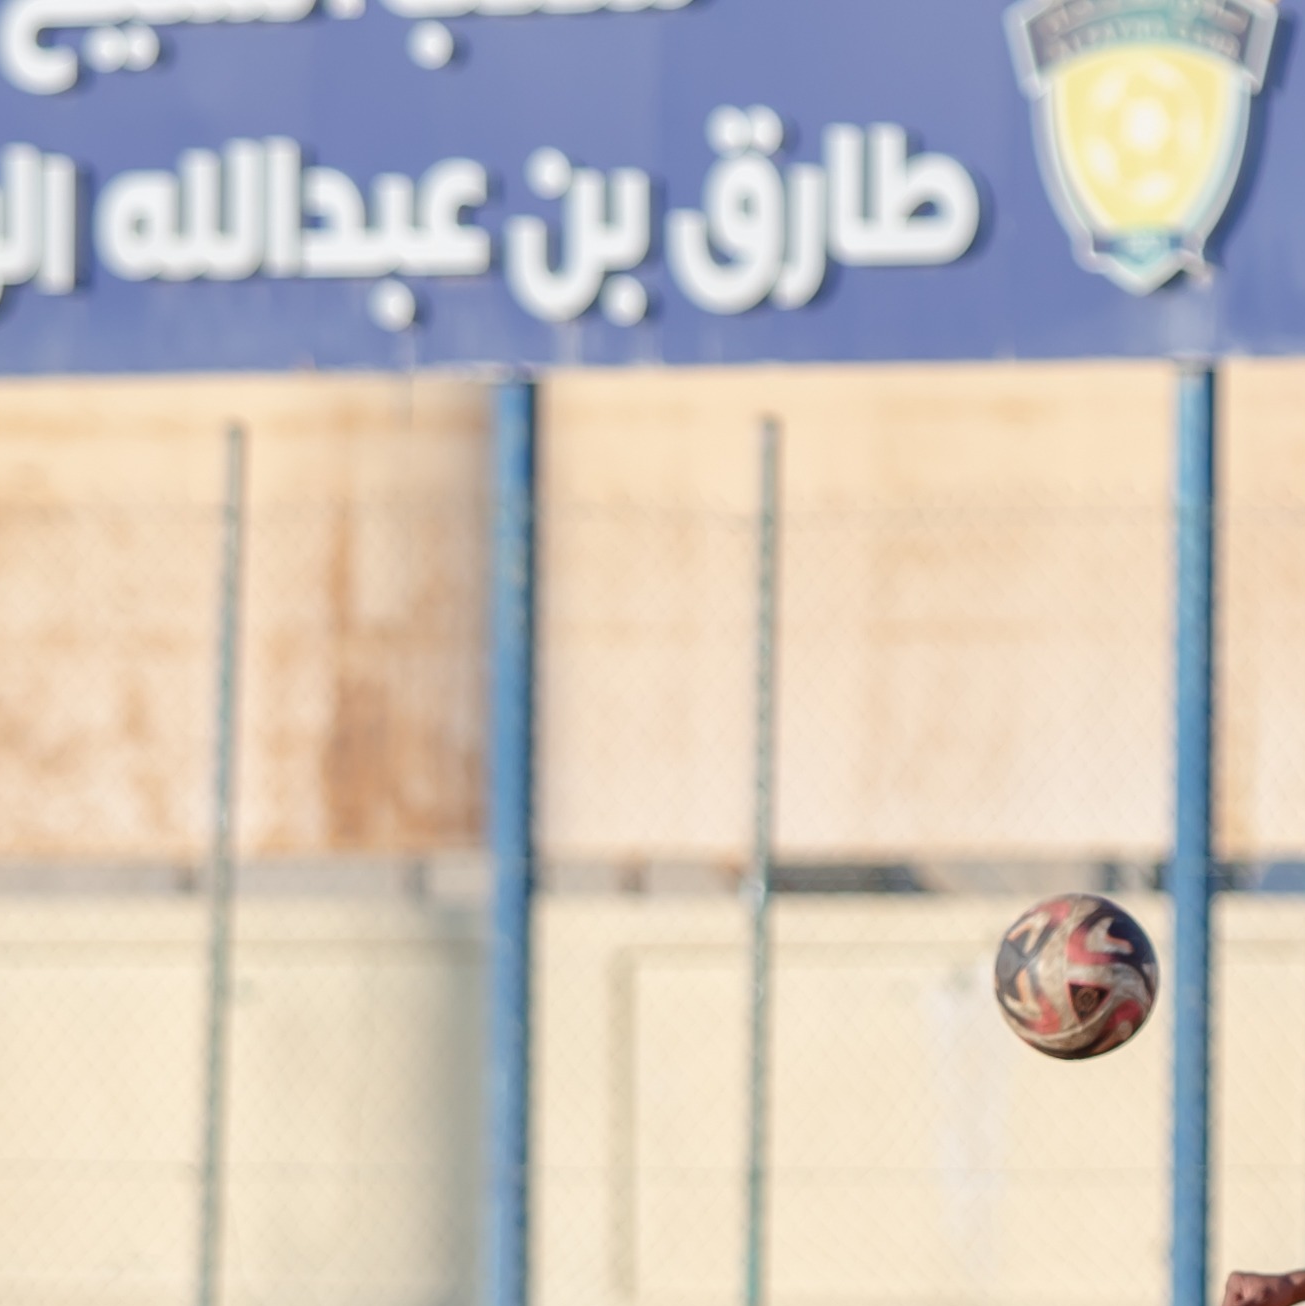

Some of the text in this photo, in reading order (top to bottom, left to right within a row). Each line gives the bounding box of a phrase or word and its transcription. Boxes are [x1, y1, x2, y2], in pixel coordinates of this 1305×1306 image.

[96, 136, 491, 330] عبدالله
[505, 146, 651, 325] بن
[666, 104, 980, 315] طارق
